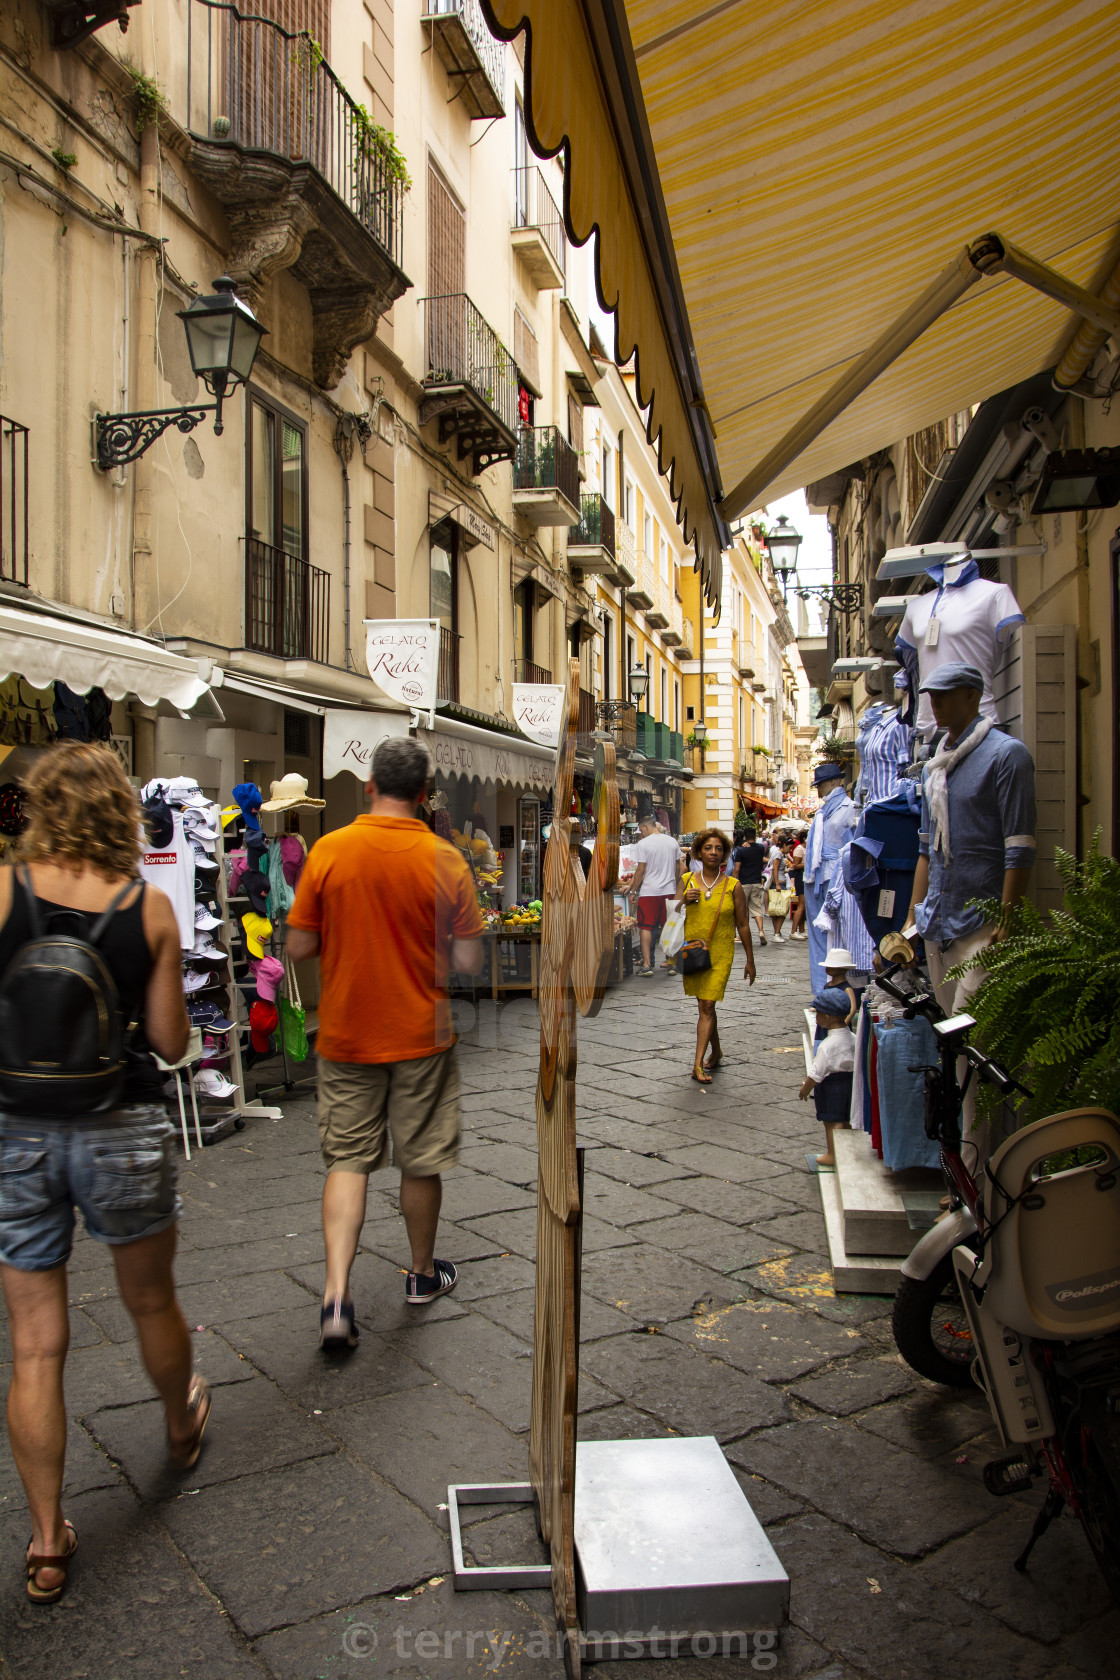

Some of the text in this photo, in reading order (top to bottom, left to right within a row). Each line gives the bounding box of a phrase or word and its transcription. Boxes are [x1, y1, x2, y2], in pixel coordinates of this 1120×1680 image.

[371, 635, 427, 647] GELATO
[373, 646, 427, 679] Raki
[516, 694, 556, 704] GELATO
[518, 703, 556, 727] Raki
[435, 743, 474, 769] GELATO
[528, 764, 553, 784] GELATO
[144, 854, 176, 864] Sorrento
